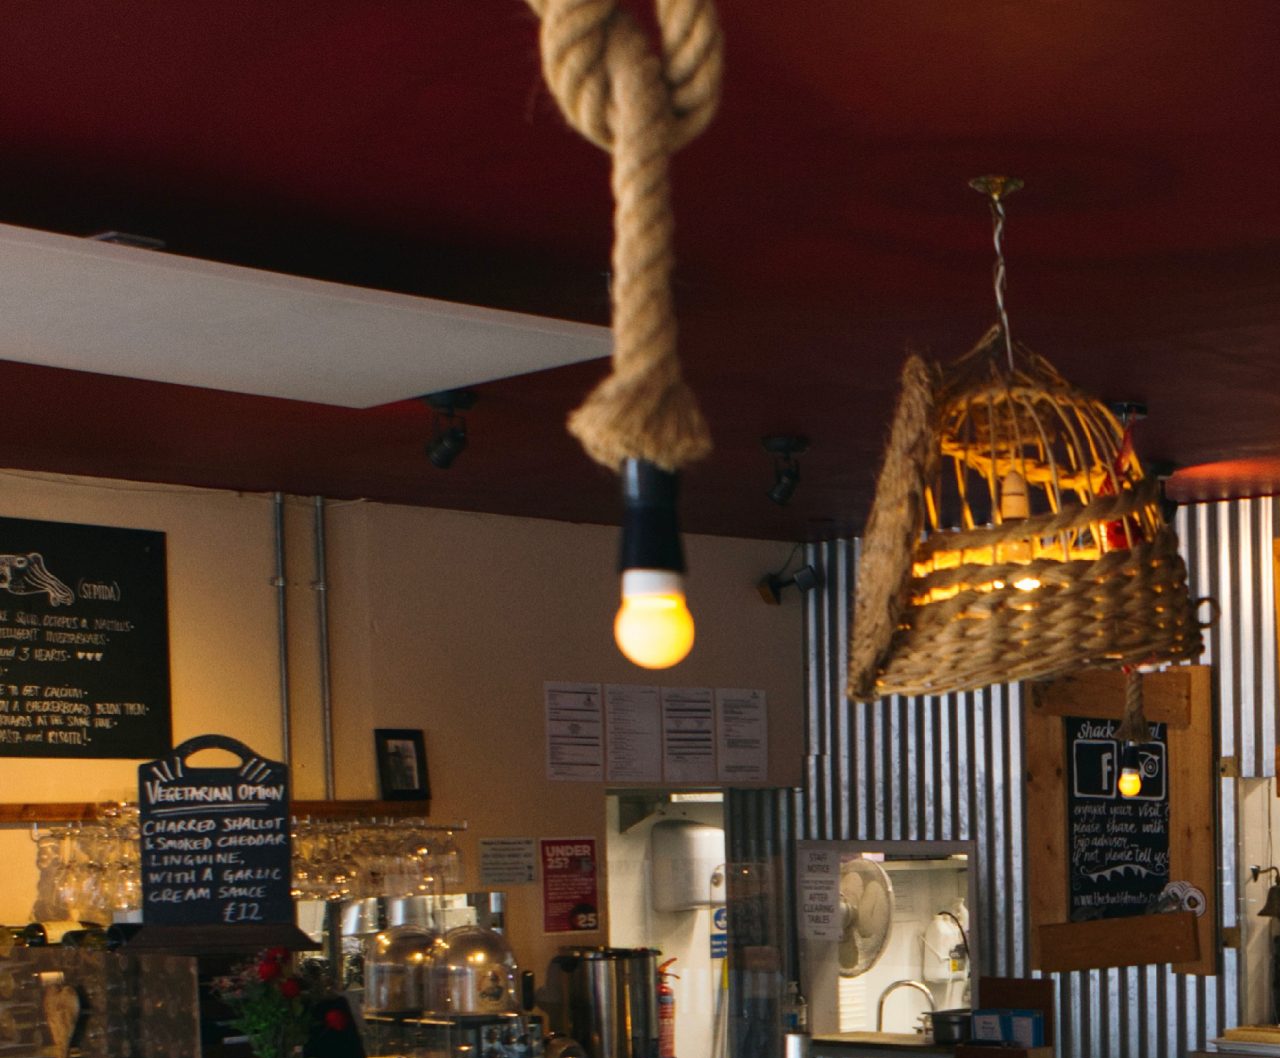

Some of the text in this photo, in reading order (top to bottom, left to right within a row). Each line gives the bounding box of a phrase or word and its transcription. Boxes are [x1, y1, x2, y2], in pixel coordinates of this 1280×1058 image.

[1077, 720, 1115, 740] Shack
[144, 780, 285, 805] VEGETARIAN OPTION
[142, 816, 286, 836] CHARRED SHALLOT
[156, 836, 213, 851] SMOKED
[216, 832, 288, 848] CHEDDAR
[545, 844, 592, 857] UNDER
[149, 867, 283, 884] WITH A GARLIC
[807, 864, 830, 873] NOTICE
[149, 885, 268, 903] CREAM SAUCE
[809, 892, 829, 902] AFTER
[222, 902, 264, 923] £12
[803, 903, 835, 914] CLEARING
[577, 913, 598, 928] 25
[807, 914, 831, 924] TABLES
